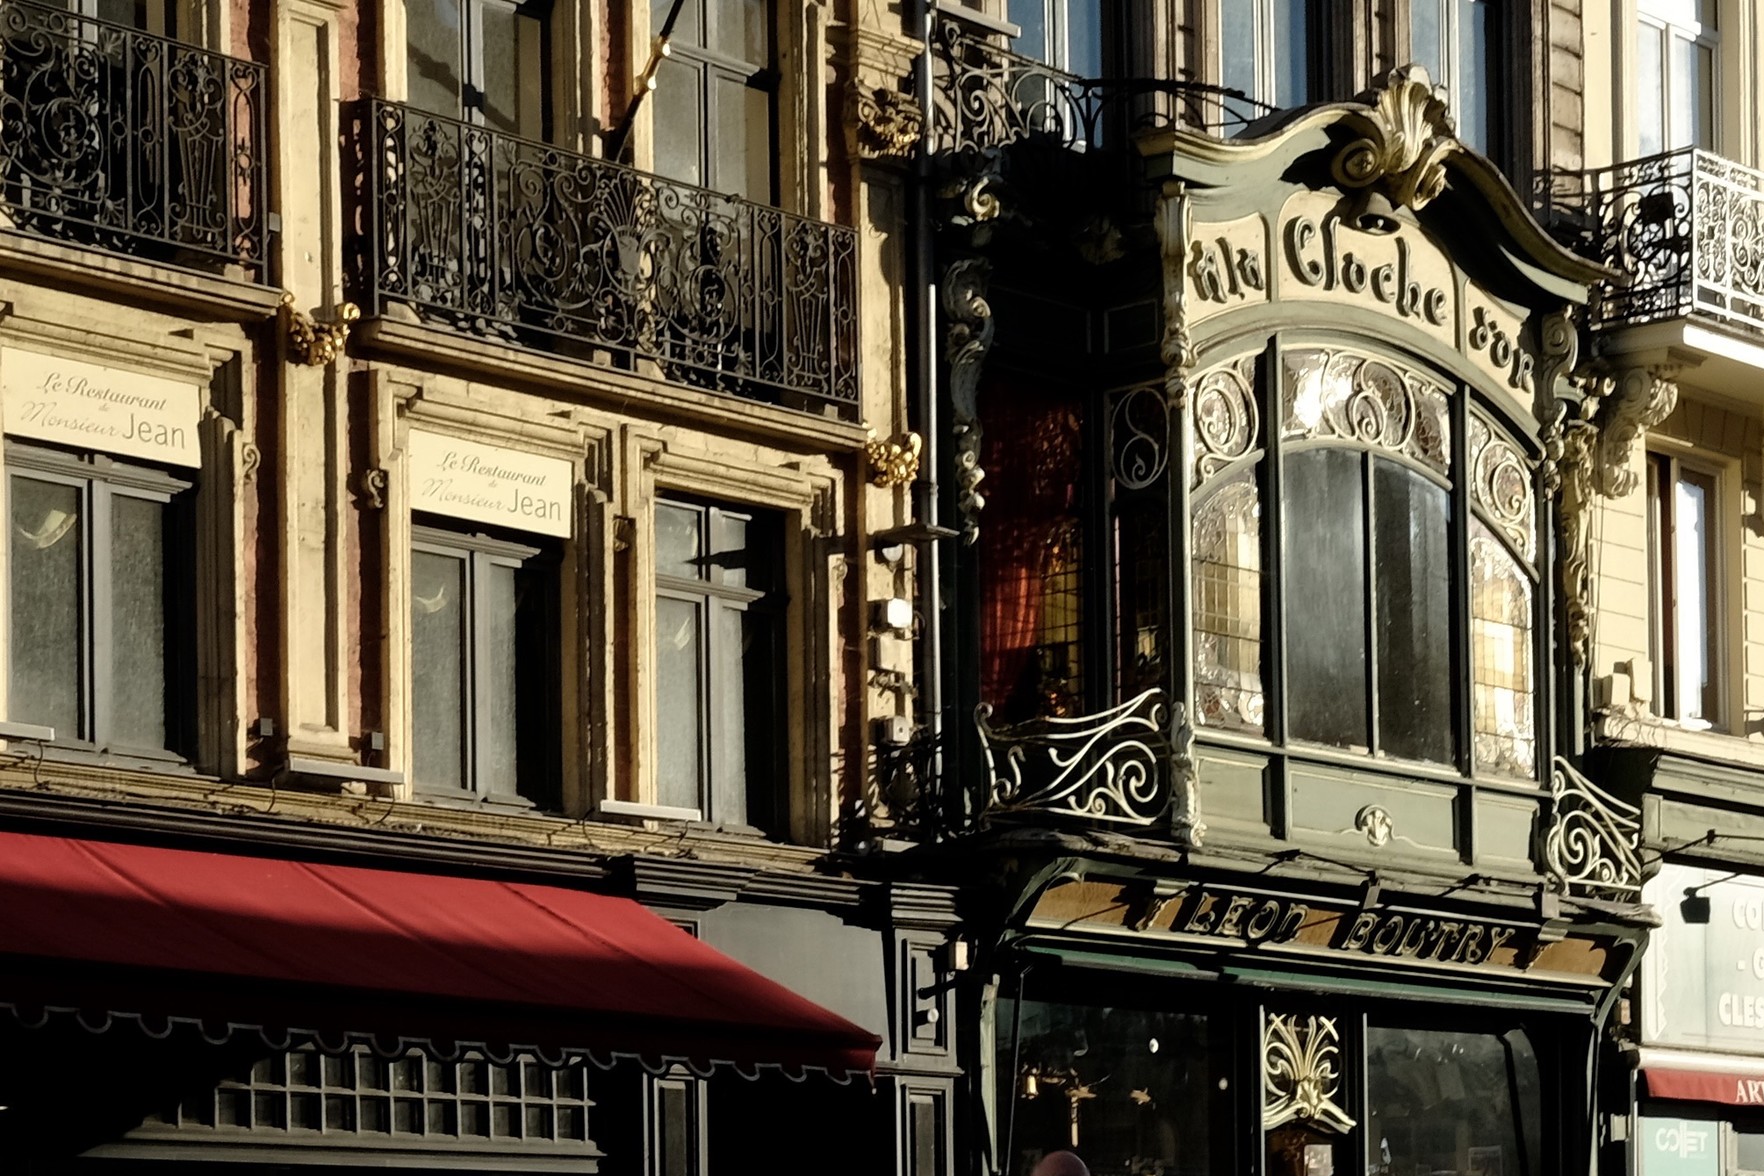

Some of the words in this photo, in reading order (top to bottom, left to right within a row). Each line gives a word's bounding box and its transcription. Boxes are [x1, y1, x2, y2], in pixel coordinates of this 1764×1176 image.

[1283, 214, 1447, 327] Cloche
[37, 371, 62, 394] Le
[65, 374, 167, 411] Restaurant
[21, 400, 119, 437] Monsieur
[122, 413, 185, 449] Jean
[436, 450, 459, 472] Le
[461, 453, 547, 487] Restaurant
[422, 477, 508, 512] Monsieur
[507, 488, 561, 521] Jean
